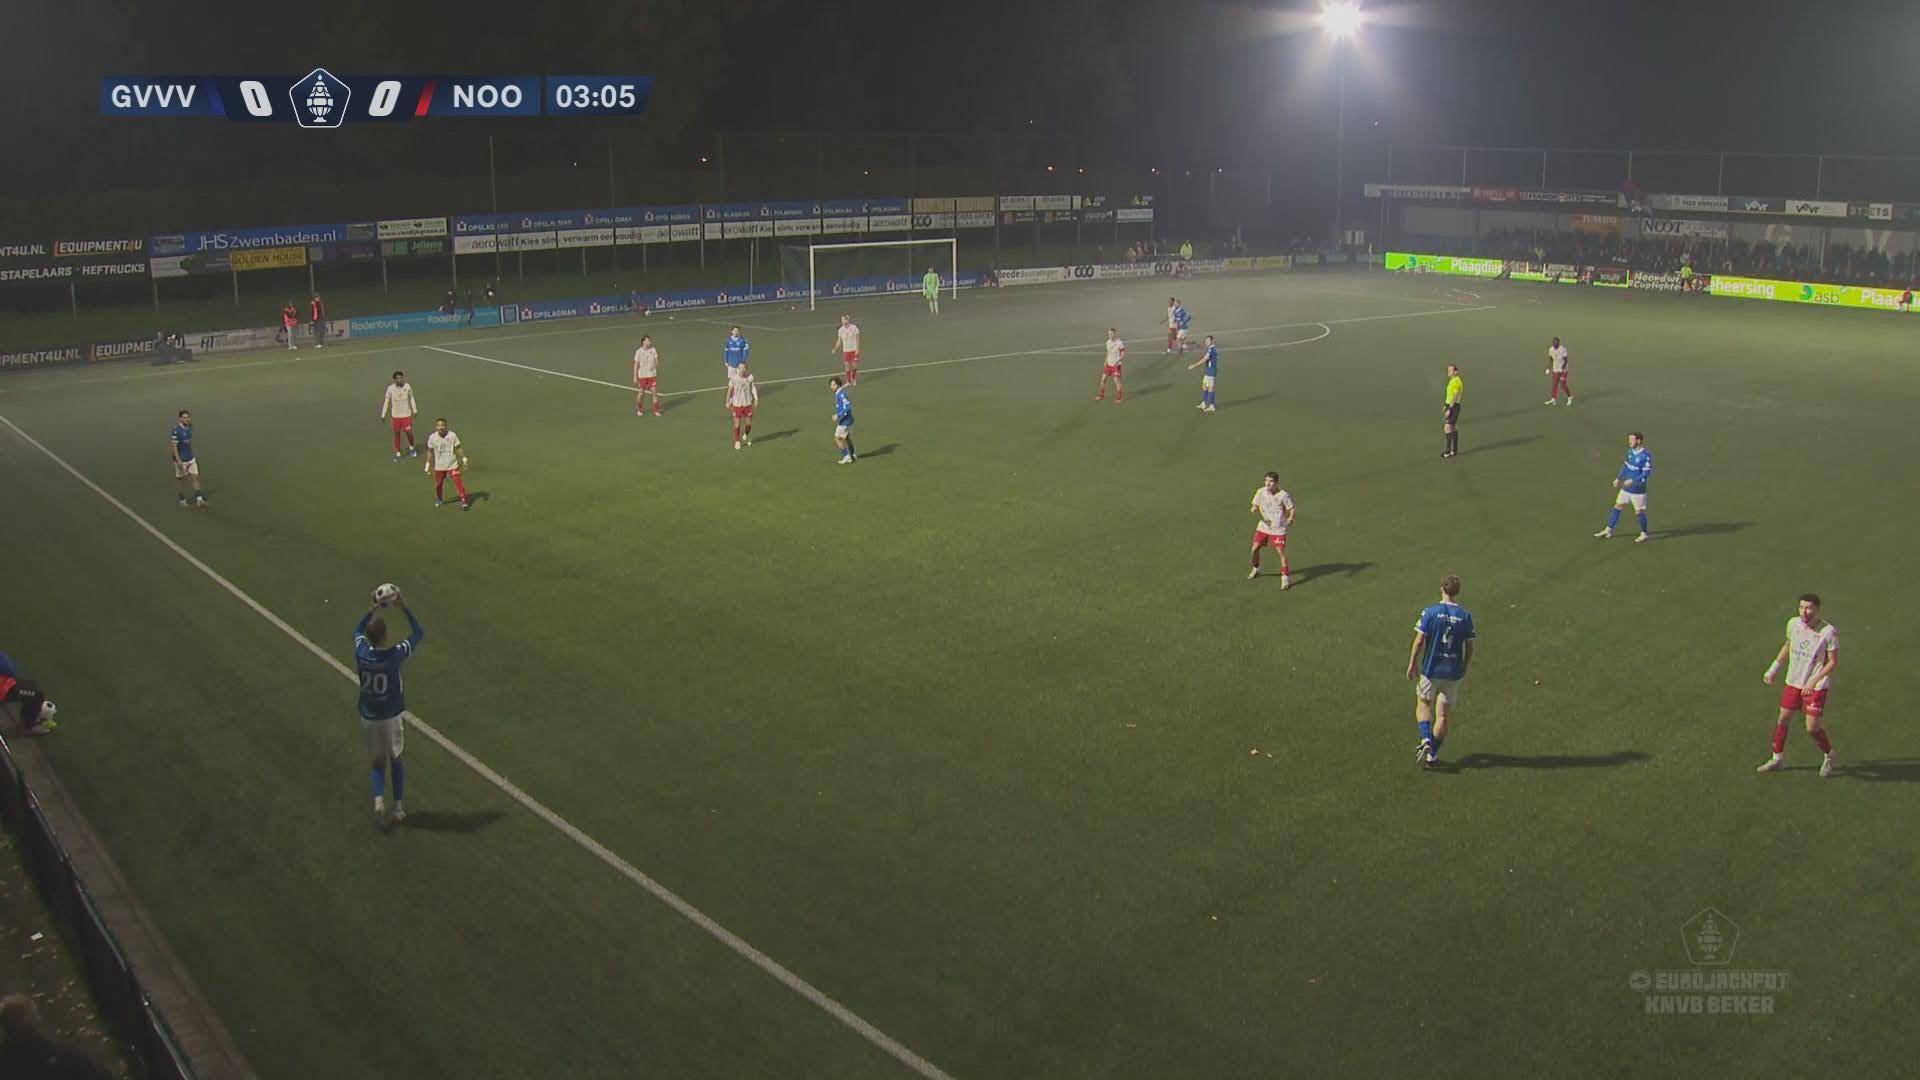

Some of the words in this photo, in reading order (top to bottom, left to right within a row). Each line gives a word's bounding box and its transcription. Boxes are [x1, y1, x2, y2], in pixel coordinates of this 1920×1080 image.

[82, 263, 145, 275] HEFTRUCKS
[533, 308, 577, 319] OPSLAGMAN
[352, 319, 399, 332] Rodenburg
[360, 670, 389, 695] 20
